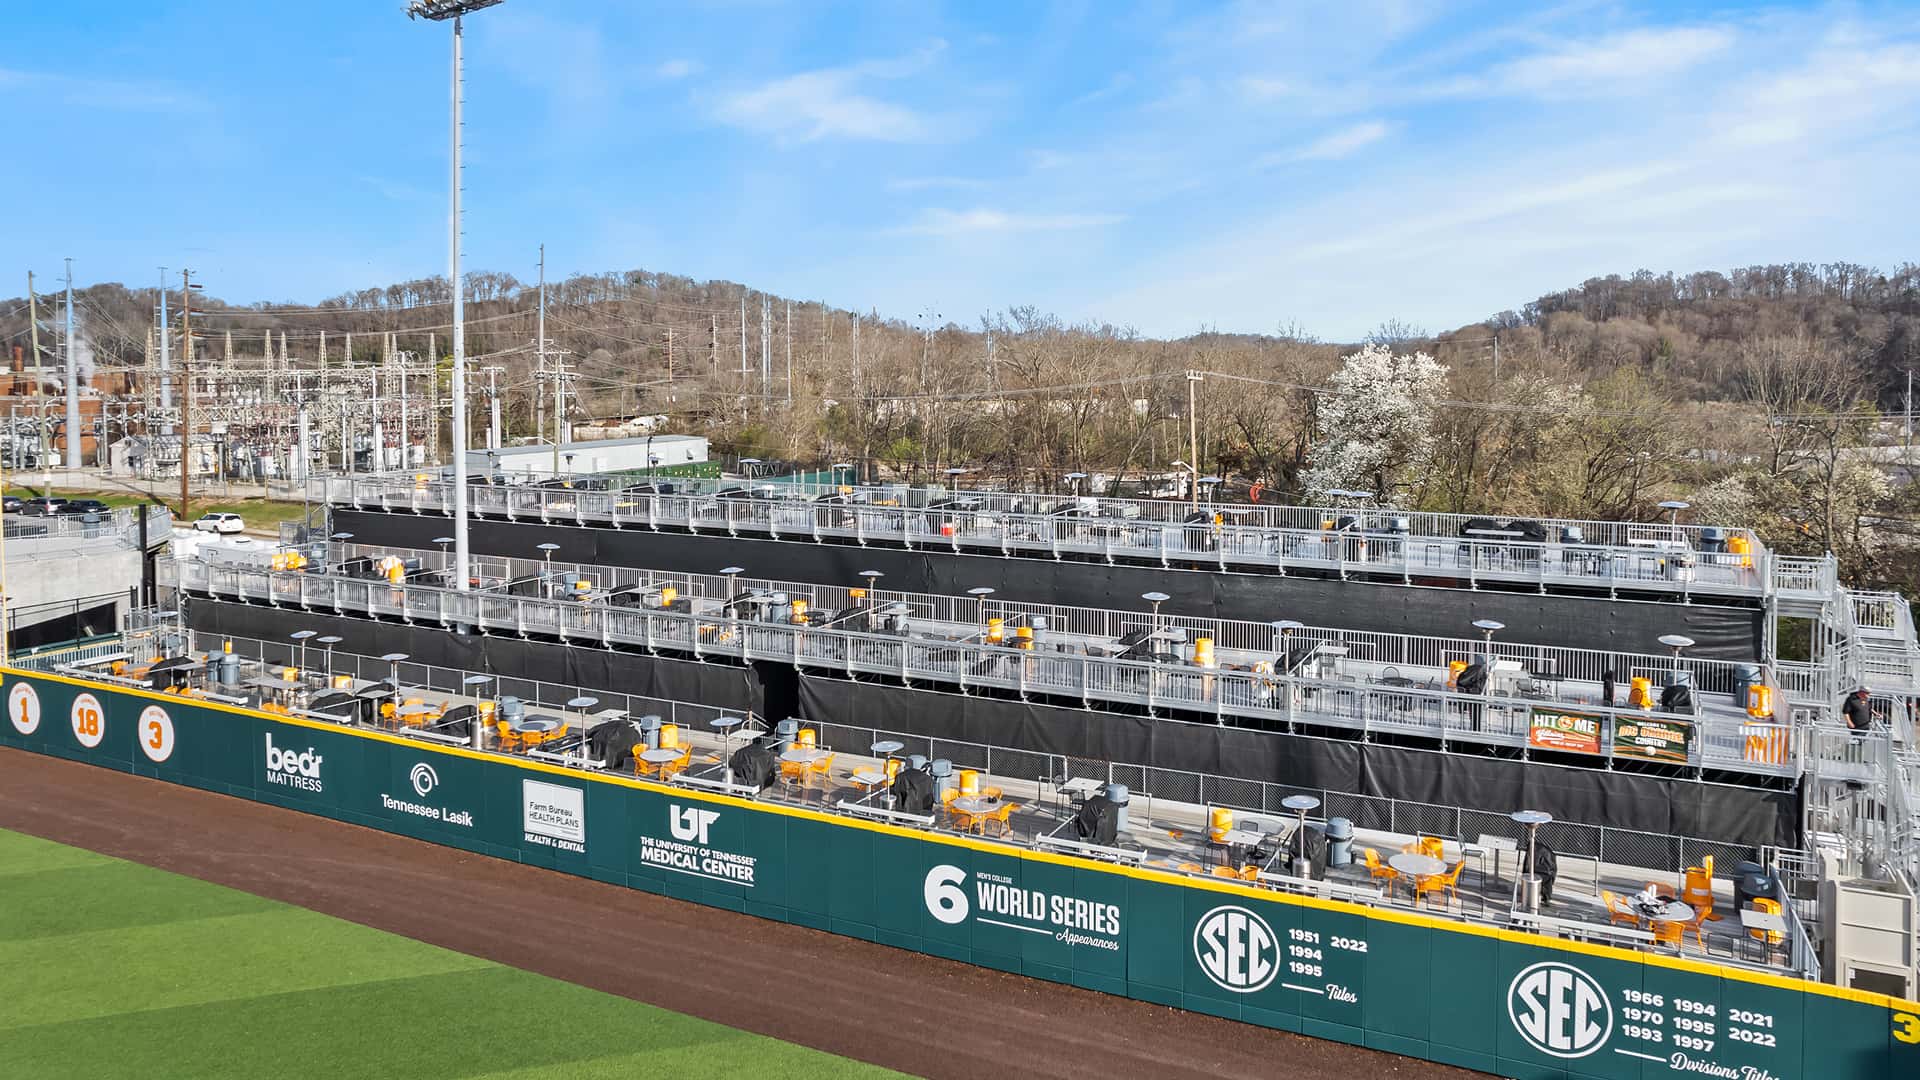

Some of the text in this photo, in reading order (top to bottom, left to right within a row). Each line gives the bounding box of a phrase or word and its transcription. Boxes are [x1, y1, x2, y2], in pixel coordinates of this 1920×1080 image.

[20, 697, 29, 723] 1
[77, 707, 99, 736] 18
[1534, 714, 1558, 728] HIT
[148, 721, 162, 749] 3
[267, 770, 323, 793] MATTRESS
[381, 793, 473, 827] Tennessee Lasik
[529, 801, 573, 817] Farm Bureau
[529, 811, 580, 829] HEALTH PLANS
[670, 804, 721, 845] UT
[524, 833, 552, 847] HEALTH
[558, 839, 586, 854] DENTAL
[640, 836, 655, 847] THE
[655, 839, 698, 856] UNIVERSITY
[699, 847, 710, 858] OF
[641, 846, 755, 882] MEDICAL CENTER
[923, 864, 970, 925] 6
[976, 881, 1121, 936] WORLD SERIES
[1055, 927, 1120, 952] Appearances
[1201, 912, 1272, 986] SEC
[1288, 928, 1369, 953] 1951 2022
[1288, 945, 1323, 961] 1994
[1288, 961, 1323, 978] 1995
[1325, 983, 1358, 1004] Titles
[1517, 969, 1602, 1050] SEC
[1622, 989, 1774, 1028] 1966 1994 2021
[1621, 1024, 1715, 1053] 1993 1997
[1622, 1007, 1777, 1048] 1970 1995 2022
[1669, 1051, 1780, 1080] Divisions Titl
